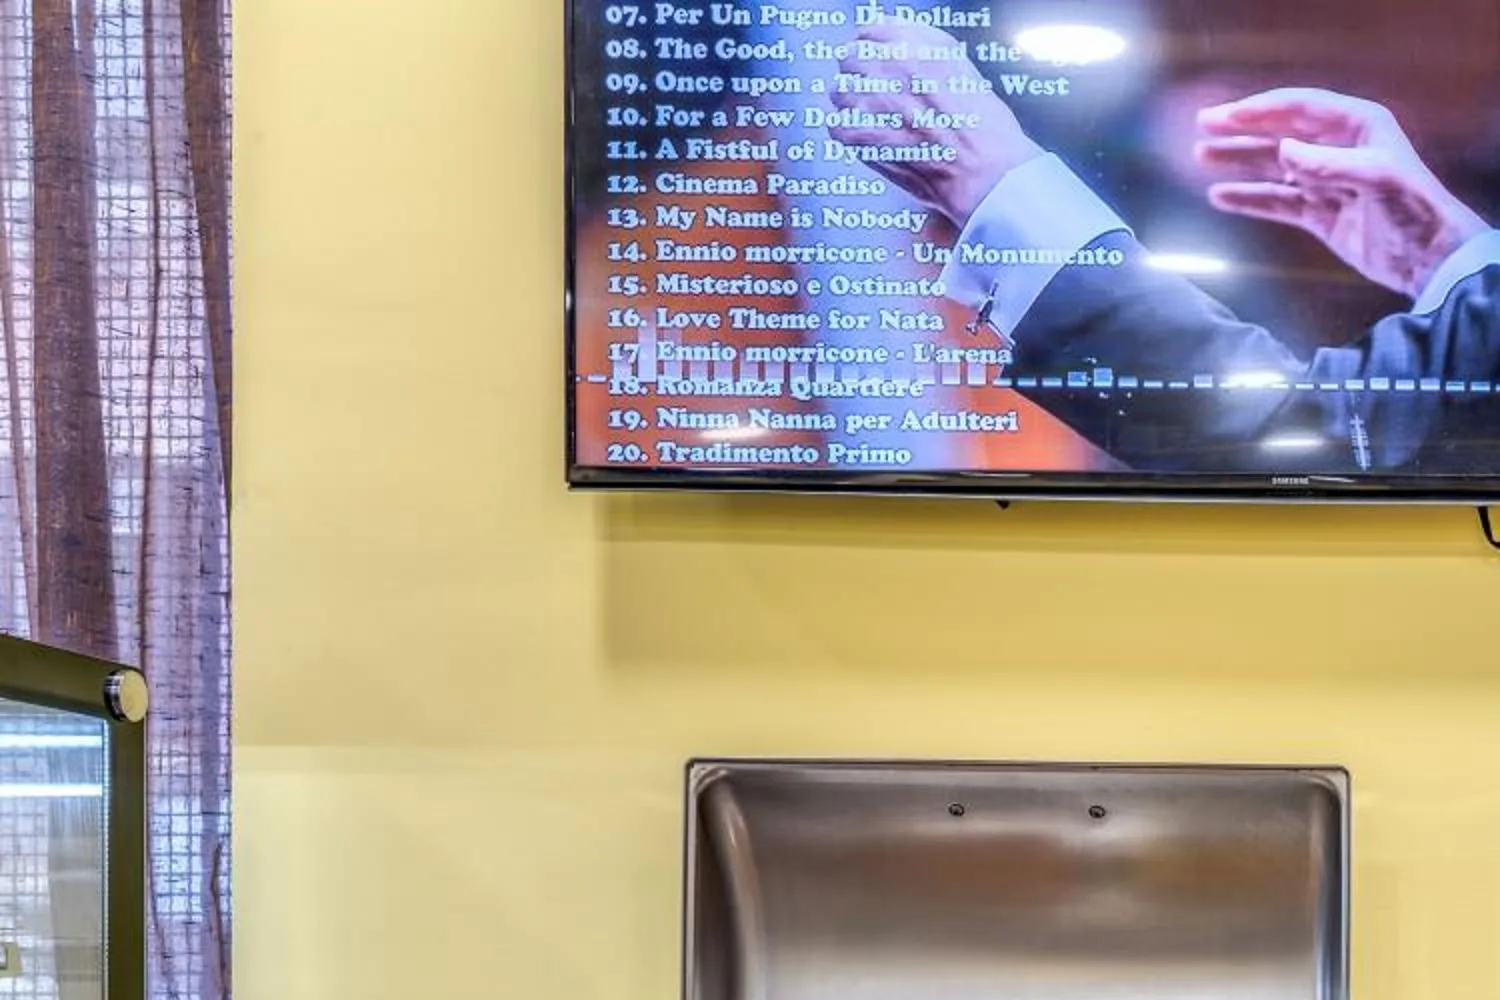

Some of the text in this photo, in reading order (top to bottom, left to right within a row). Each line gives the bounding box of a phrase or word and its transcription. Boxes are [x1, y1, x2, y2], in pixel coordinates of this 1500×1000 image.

[606, 3, 991, 30] 07. Per Un Pugno Di Dollari
[606, 38, 647, 59] 08.
[654, 37, 708, 59] The
[715, 38, 795, 63] Good,
[804, 40, 849, 60] the
[857, 40, 908, 61] Bad
[918, 41, 967, 62] and
[976, 41, 1023, 62] the
[606, 70, 1070, 97] 09. Once upon a Time in the West
[607, 106, 981, 128] 10. For a Few Dollars More
[607, 138, 958, 164] 11. A Fistful of Dynamite
[607, 173, 887, 196] 12. Cinema Paradiso
[607, 206, 928, 232] 13. My Name is Nobody
[607, 243, 648, 262] 14.
[655, 240, 737, 262] Ennio
[745, 242, 887, 262] morricone
[912, 243, 953, 263] Un
[961, 243, 1124, 265] Monumento
[607, 273, 946, 297] 15. Misterioso e Ostinato
[607, 307, 944, 330] 16. Love Theme for Nata
[656, 341, 737, 361] Ennio
[745, 342, 888, 363] morricone
[912, 342, 1013, 364] L'arena
[608, 376, 648, 395] 18.
[656, 375, 782, 396] Romanza
[608, 407, 1019, 433] 19. Ninna Nanna per Adulteri
[607, 441, 912, 465] 20. Tradimento Primo
